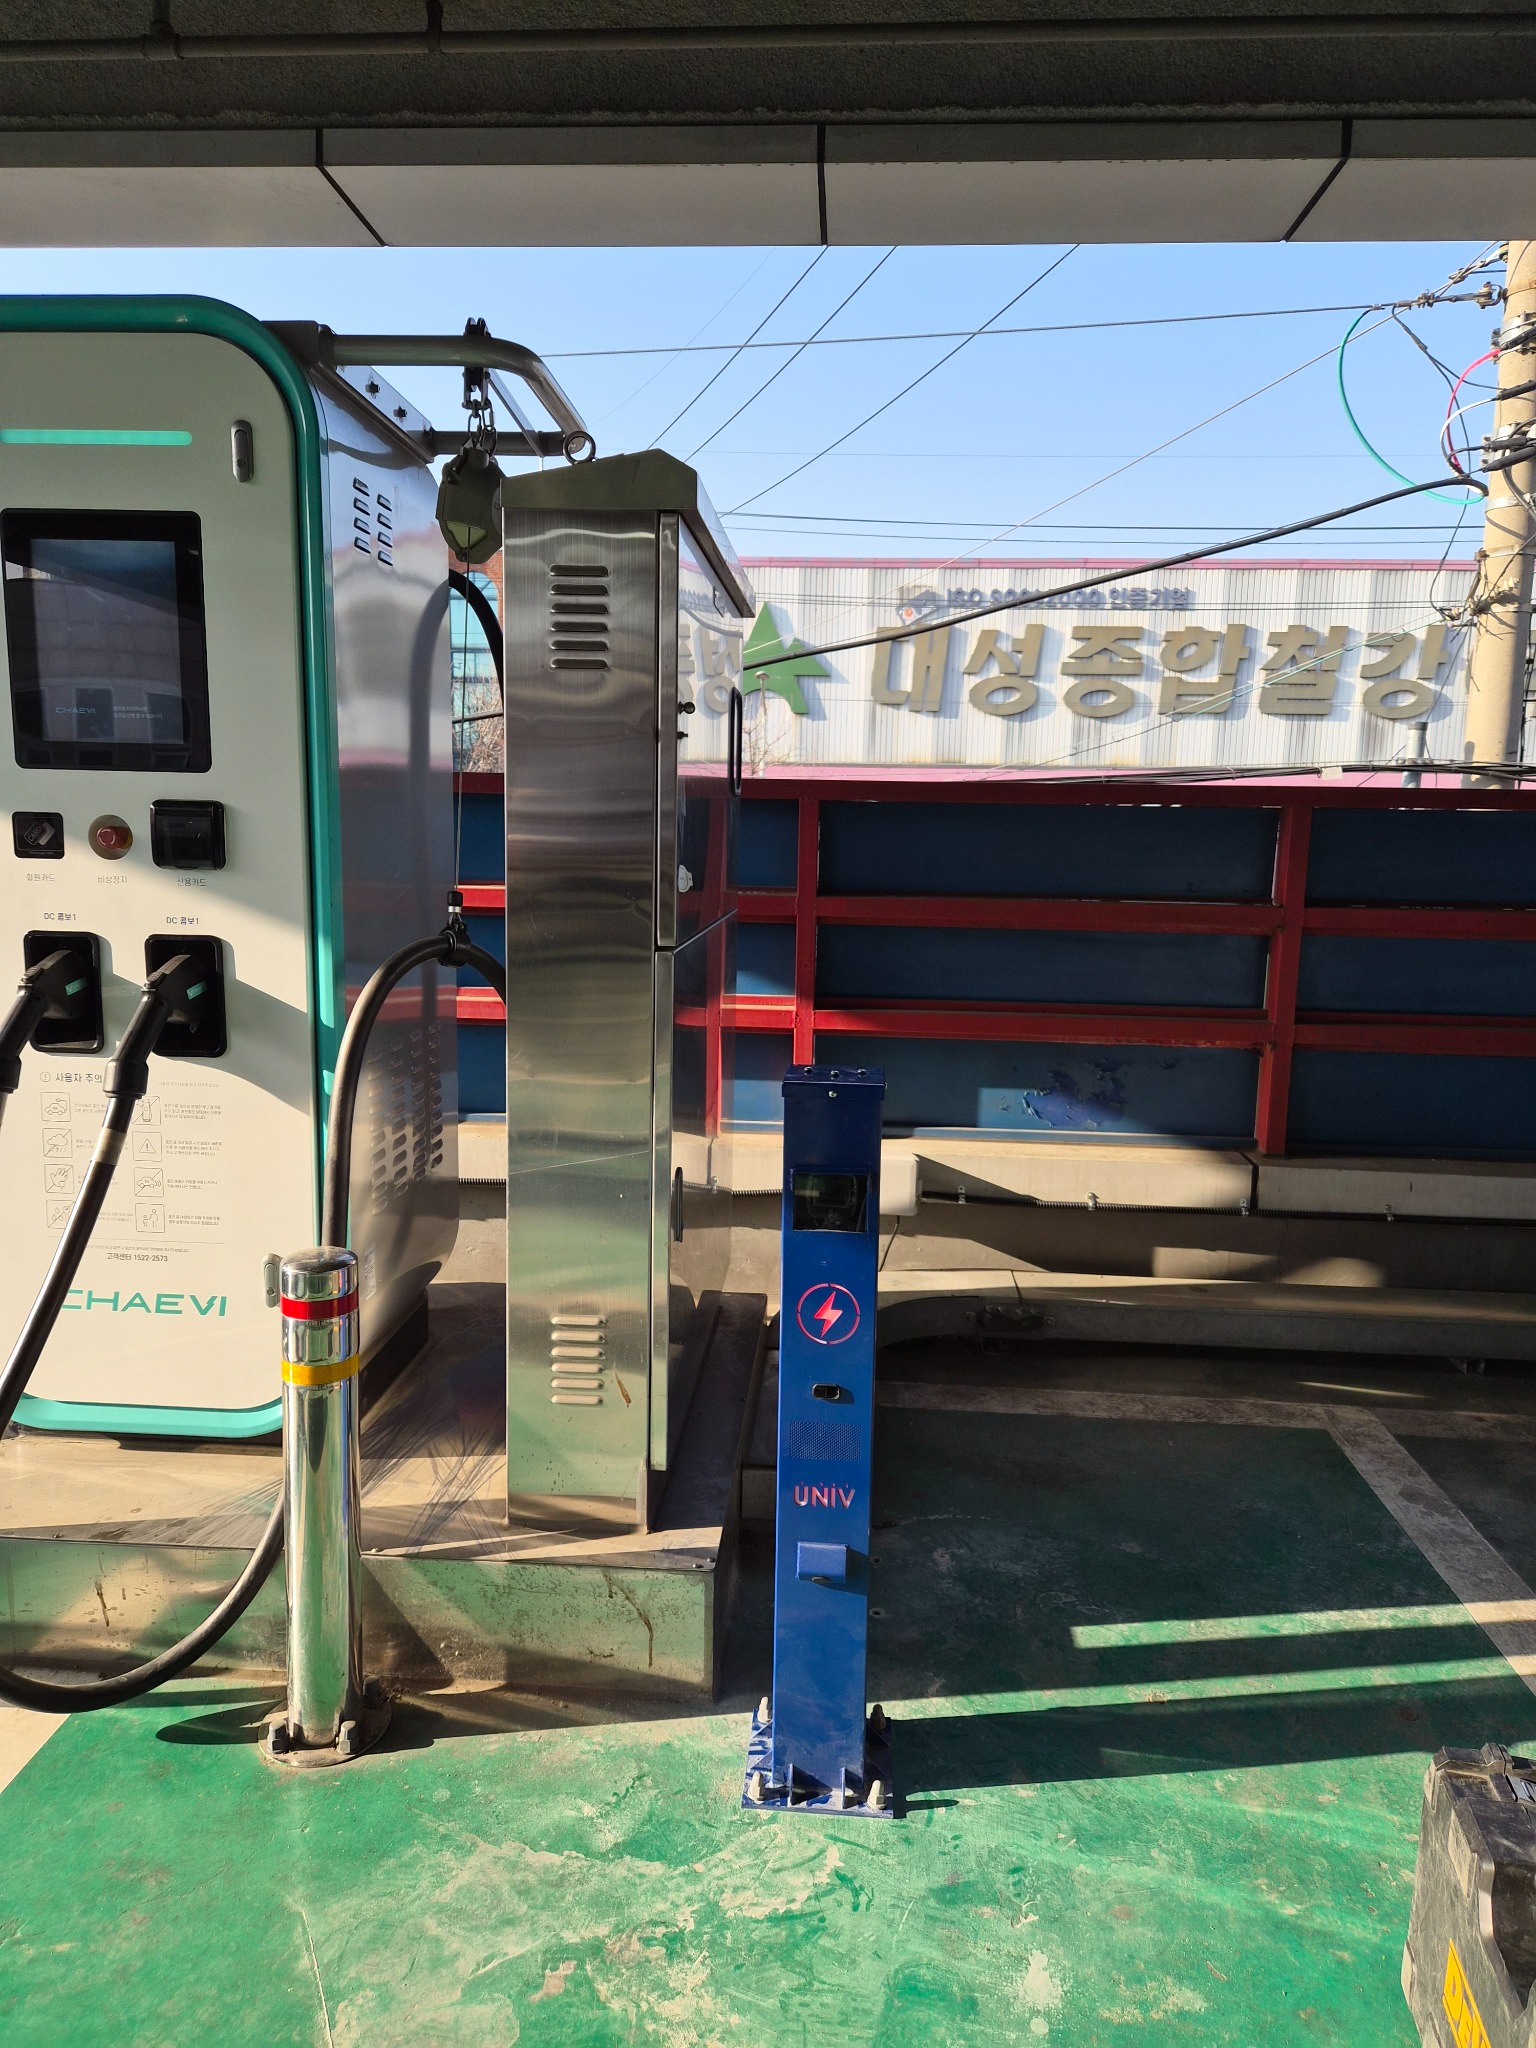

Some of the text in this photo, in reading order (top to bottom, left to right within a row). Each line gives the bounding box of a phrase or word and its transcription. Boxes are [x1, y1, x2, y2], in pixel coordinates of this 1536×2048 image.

[947, 587, 983, 607] ISO
[990, 586, 1103, 608] 9002000
[871, 623, 1448, 720] 대성종합철강
[97, 875, 128, 885] 비상정지
[176, 878, 207, 887] 신용카드
[43, 912, 55, 920] DC
[166, 916, 178, 925] DC
[55, 1072, 83, 1083] 사용자
[106, 1252, 169, 1262] 고객센터 1522-2573
[794, 1485, 856, 1509] UNIV
